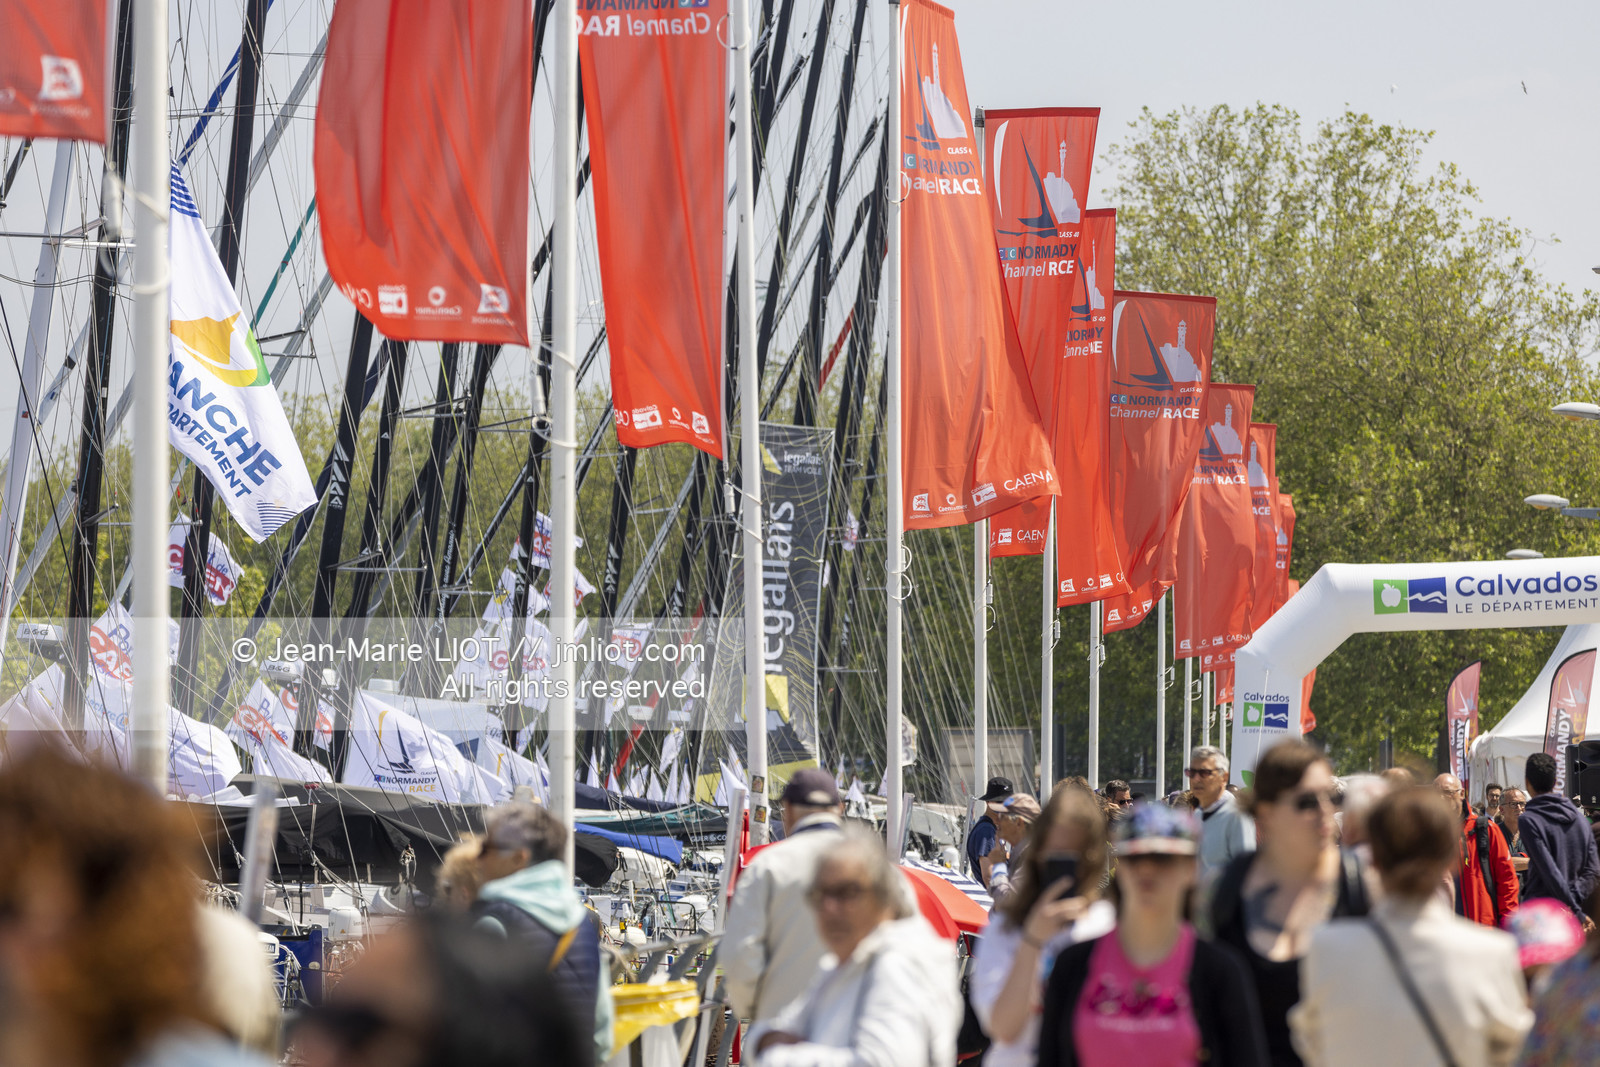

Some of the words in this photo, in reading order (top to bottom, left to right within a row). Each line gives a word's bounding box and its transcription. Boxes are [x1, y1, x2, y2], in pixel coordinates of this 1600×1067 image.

[1129, 395, 1200, 406] NORMANDY
[1110, 406, 1160, 418] Channel
[1163, 408, 1199, 419] RACE
[168, 353, 282, 486] ANCHE
[1217, 475, 1246, 484] RACE
[1455, 571, 1598, 597] Calvados
[1455, 603, 1473, 613] LE
[1482, 597, 1598, 613] DÉPARTEMENT
[24, 628, 48, 636] B&G
[267, 664, 290, 672] B&G
[1244, 692, 1290, 702] Calvados
[386, 776, 437, 784] NORMANDY
[409, 784, 435, 792] RACE
